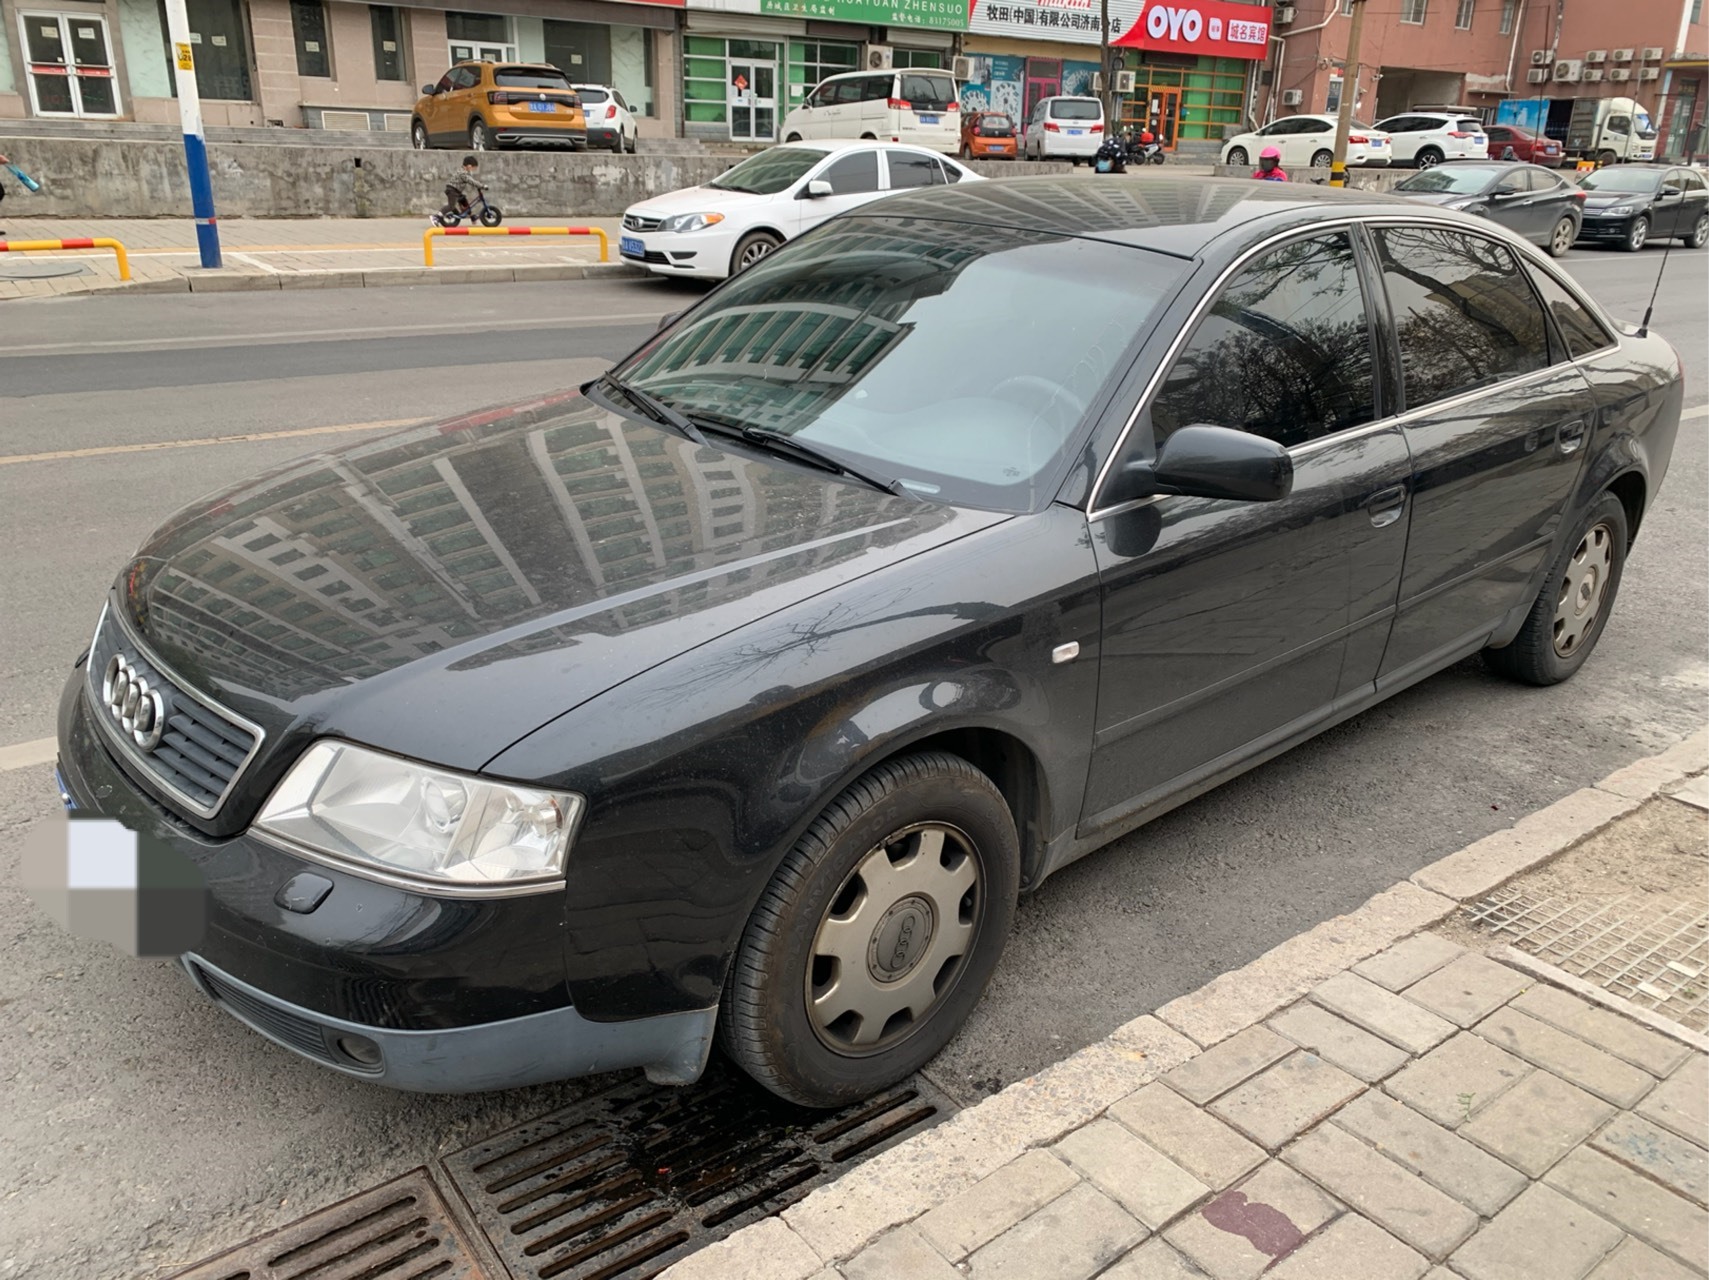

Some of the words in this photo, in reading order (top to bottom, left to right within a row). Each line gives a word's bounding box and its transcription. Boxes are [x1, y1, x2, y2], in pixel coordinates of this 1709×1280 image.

[904, 0, 963, 15] ZHENSUO
[987, 4, 1122, 33] 牧田(中国)有限公司济南店
[1147, 5, 1203, 42] OYO
[1230, 22, 1266, 41] 城名宾馆
